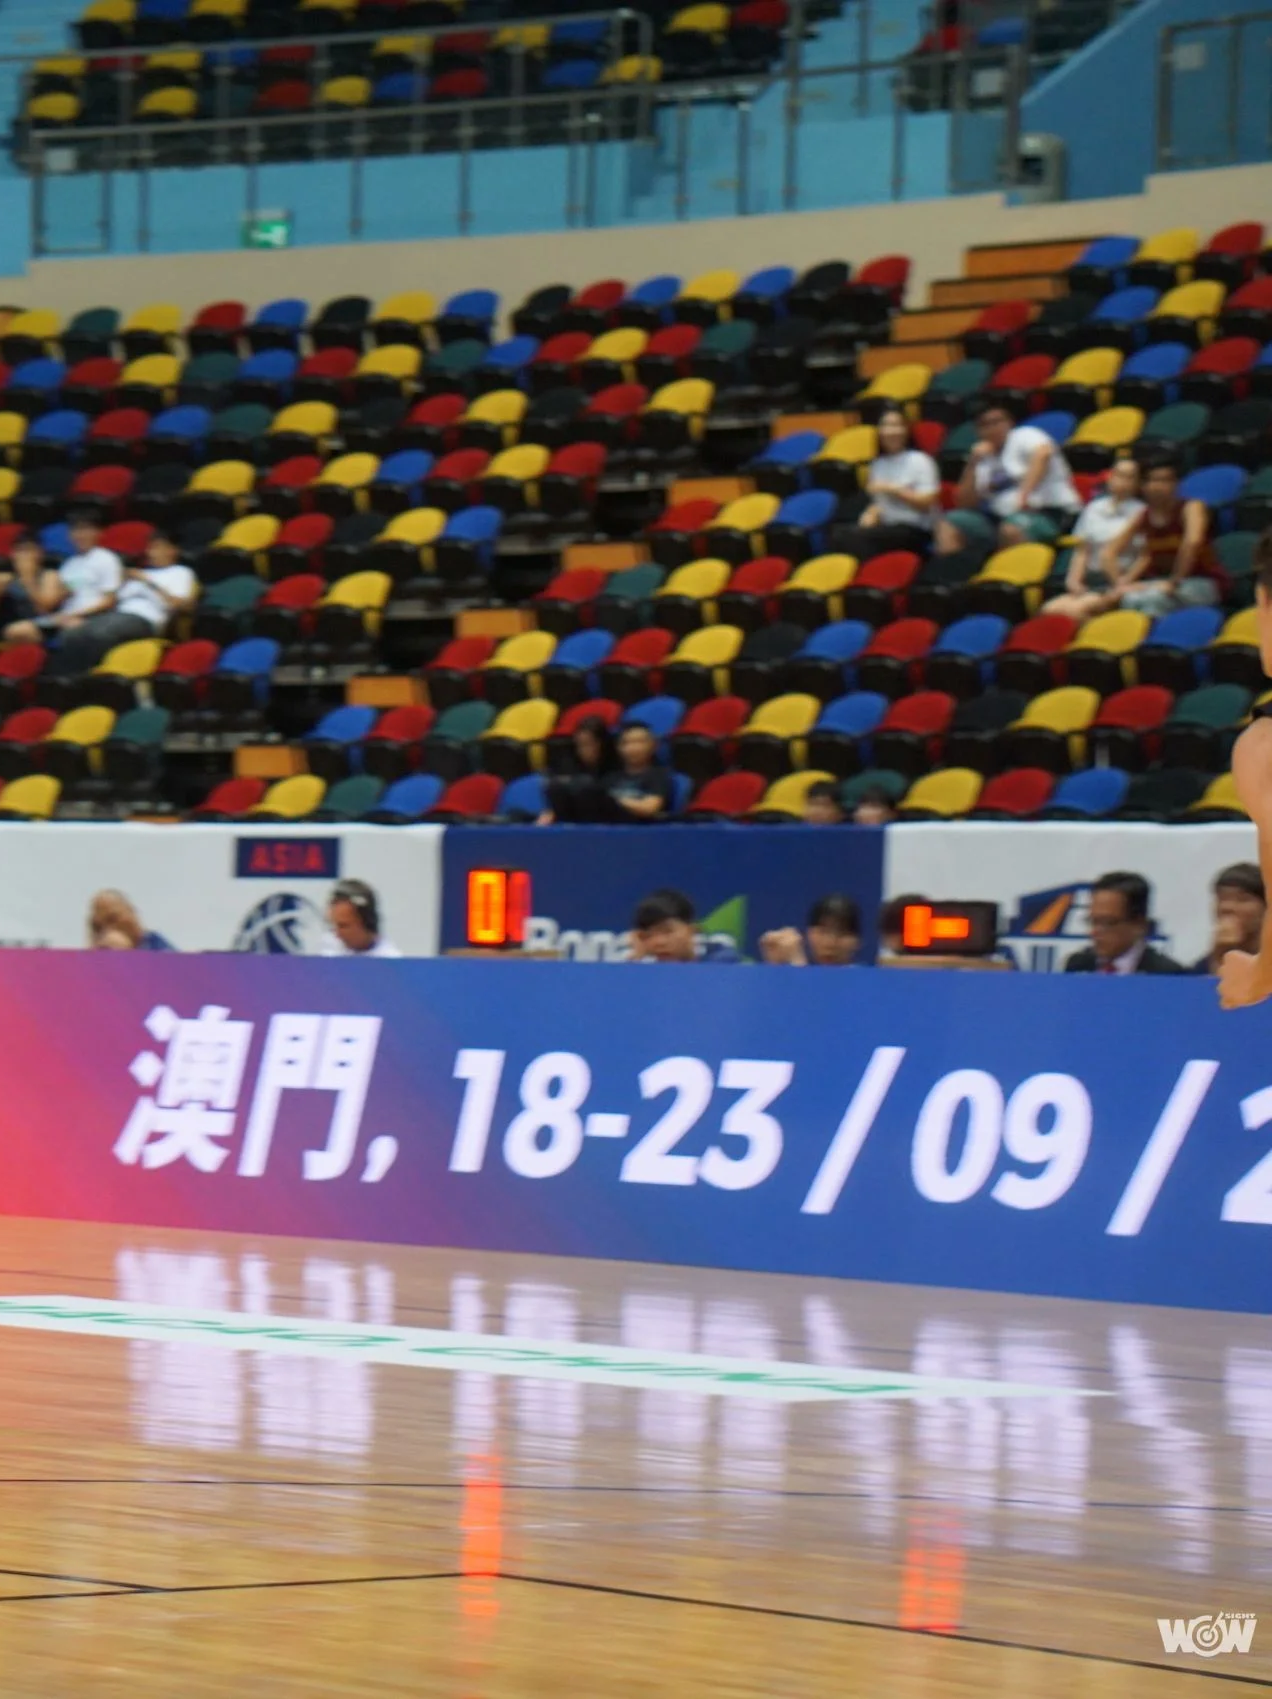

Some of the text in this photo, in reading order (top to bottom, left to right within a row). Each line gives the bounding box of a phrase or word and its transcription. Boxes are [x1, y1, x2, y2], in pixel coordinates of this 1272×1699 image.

[113, 1004, 399, 1182] 澳門,
[448, 1048, 795, 1191] 18-23
[800, 1046, 907, 1215] /
[911, 1068, 1094, 1211] 09
[1104, 1058, 1221, 1236] /
[410, 1345, 916, 1394] CHINA
